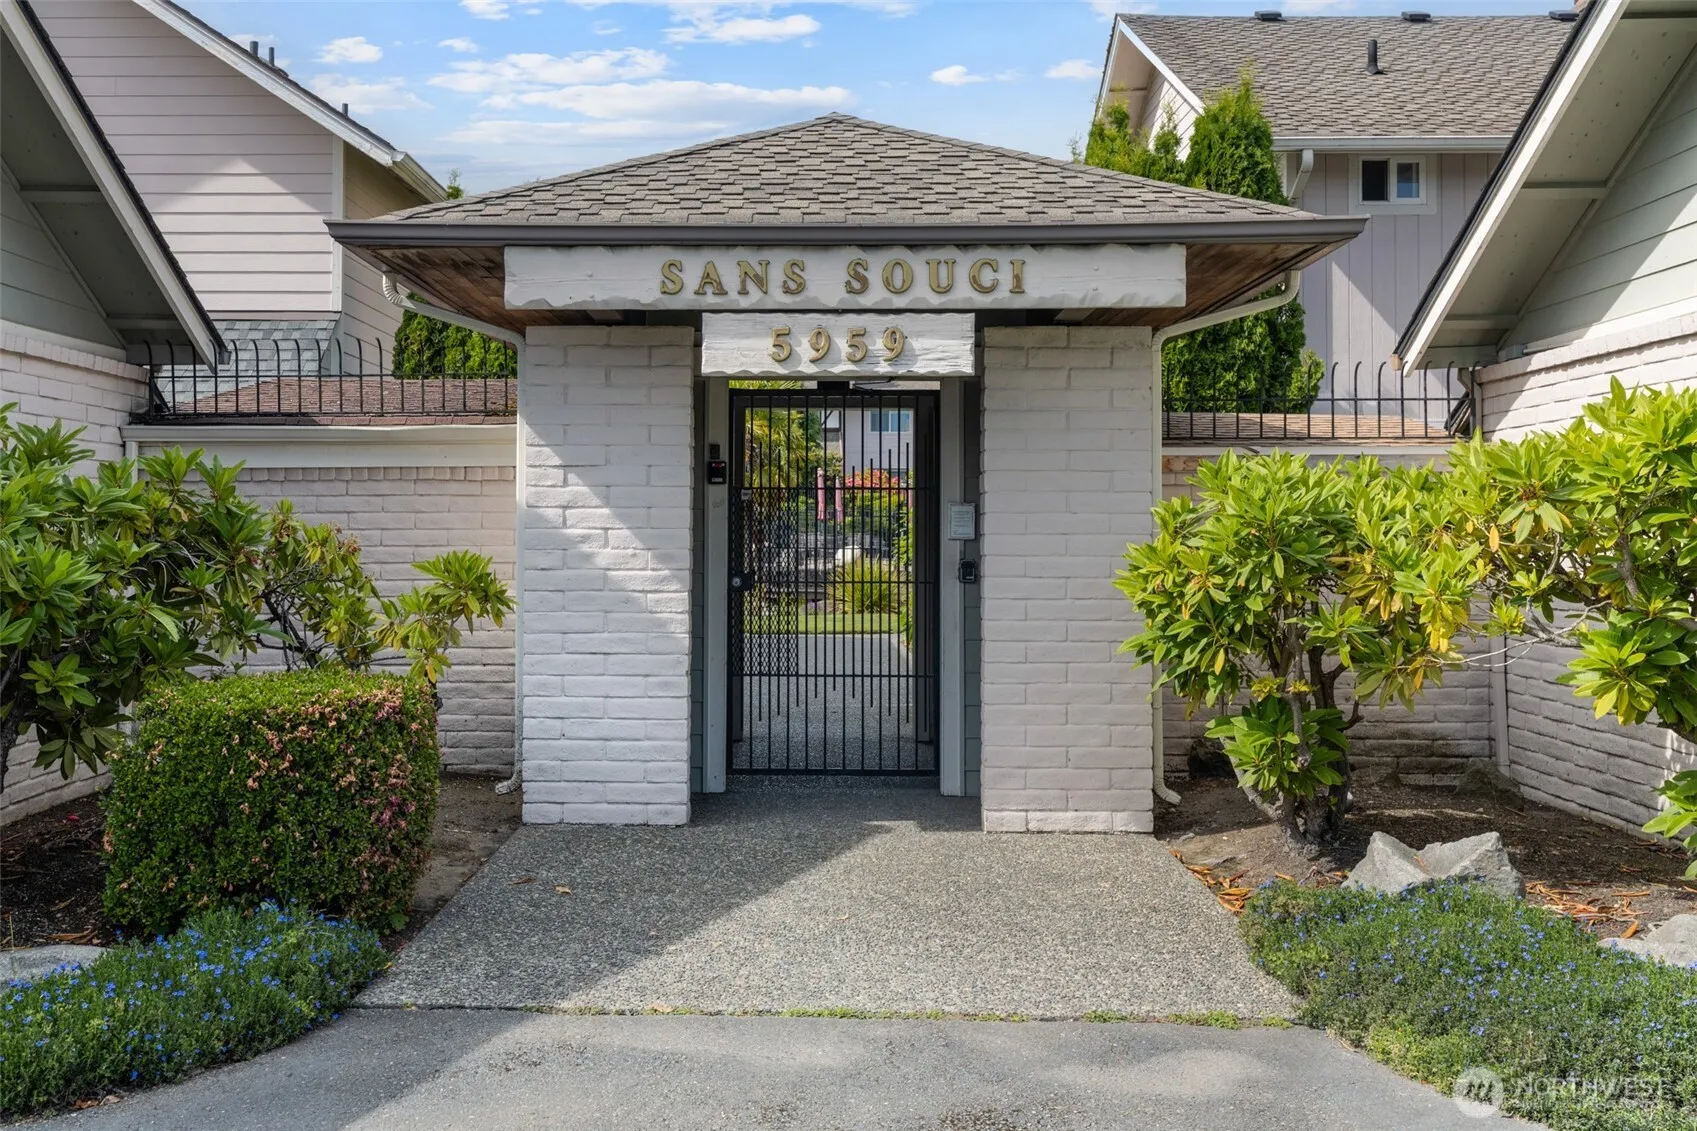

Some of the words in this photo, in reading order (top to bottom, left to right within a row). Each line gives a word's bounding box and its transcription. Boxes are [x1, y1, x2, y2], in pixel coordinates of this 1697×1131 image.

[660, 260, 806, 295] SANS
[845, 258, 1026, 294] SOUCI
[771, 327, 905, 363] 5959
